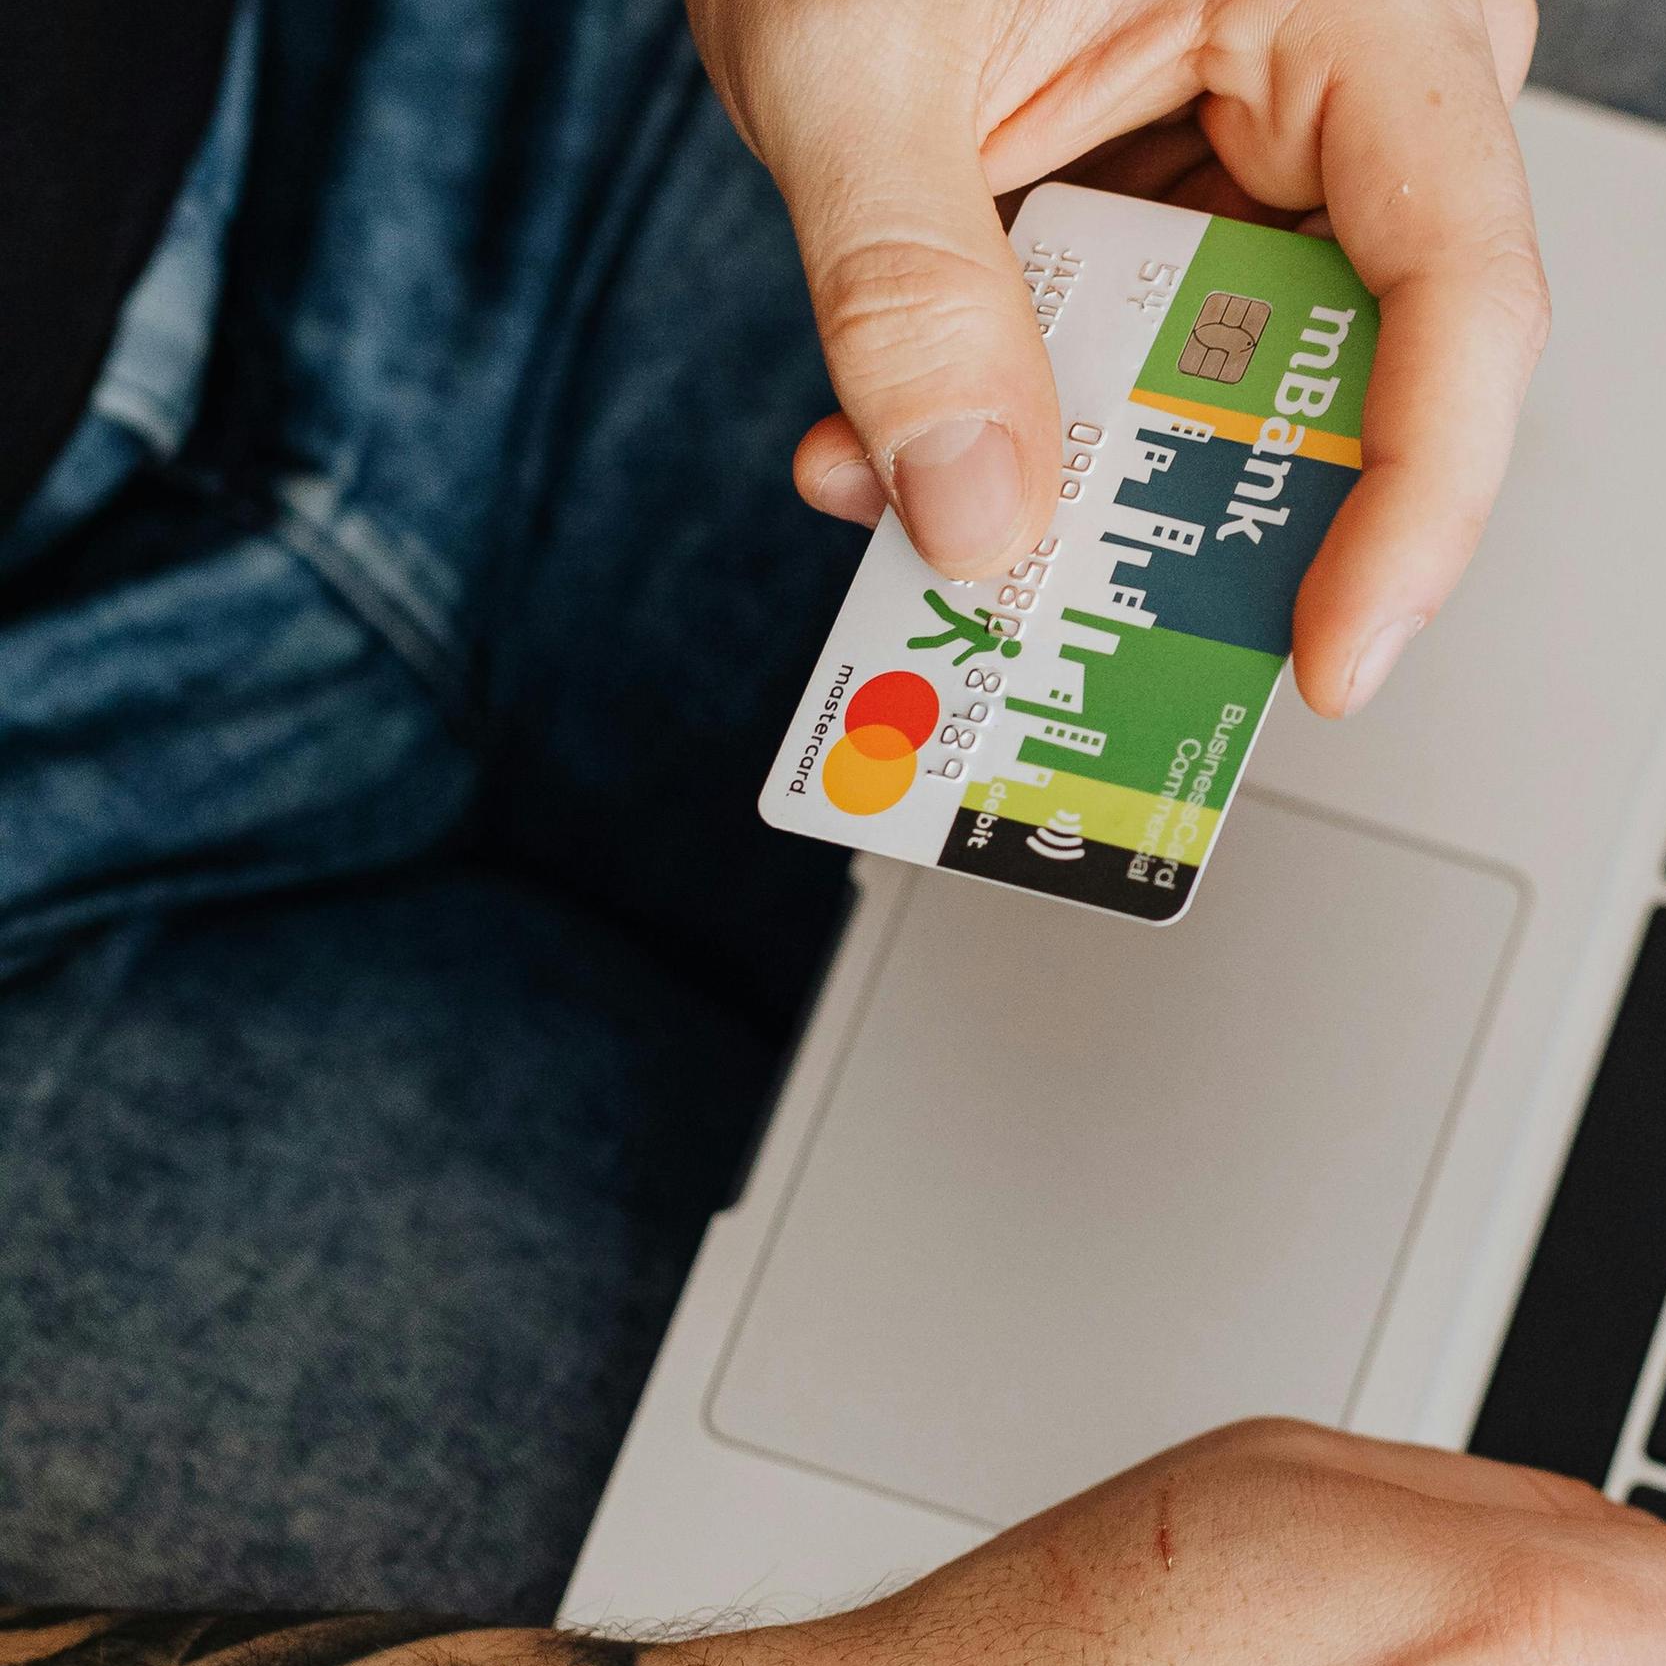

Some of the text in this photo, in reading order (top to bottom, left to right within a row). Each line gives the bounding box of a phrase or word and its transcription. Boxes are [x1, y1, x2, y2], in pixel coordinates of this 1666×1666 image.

[1216, 304, 1356, 545] mBank
[966, 781, 1007, 849] debit
[1124, 738, 1200, 882] Commercial
[1152, 705, 1246, 889] BusinessCard
